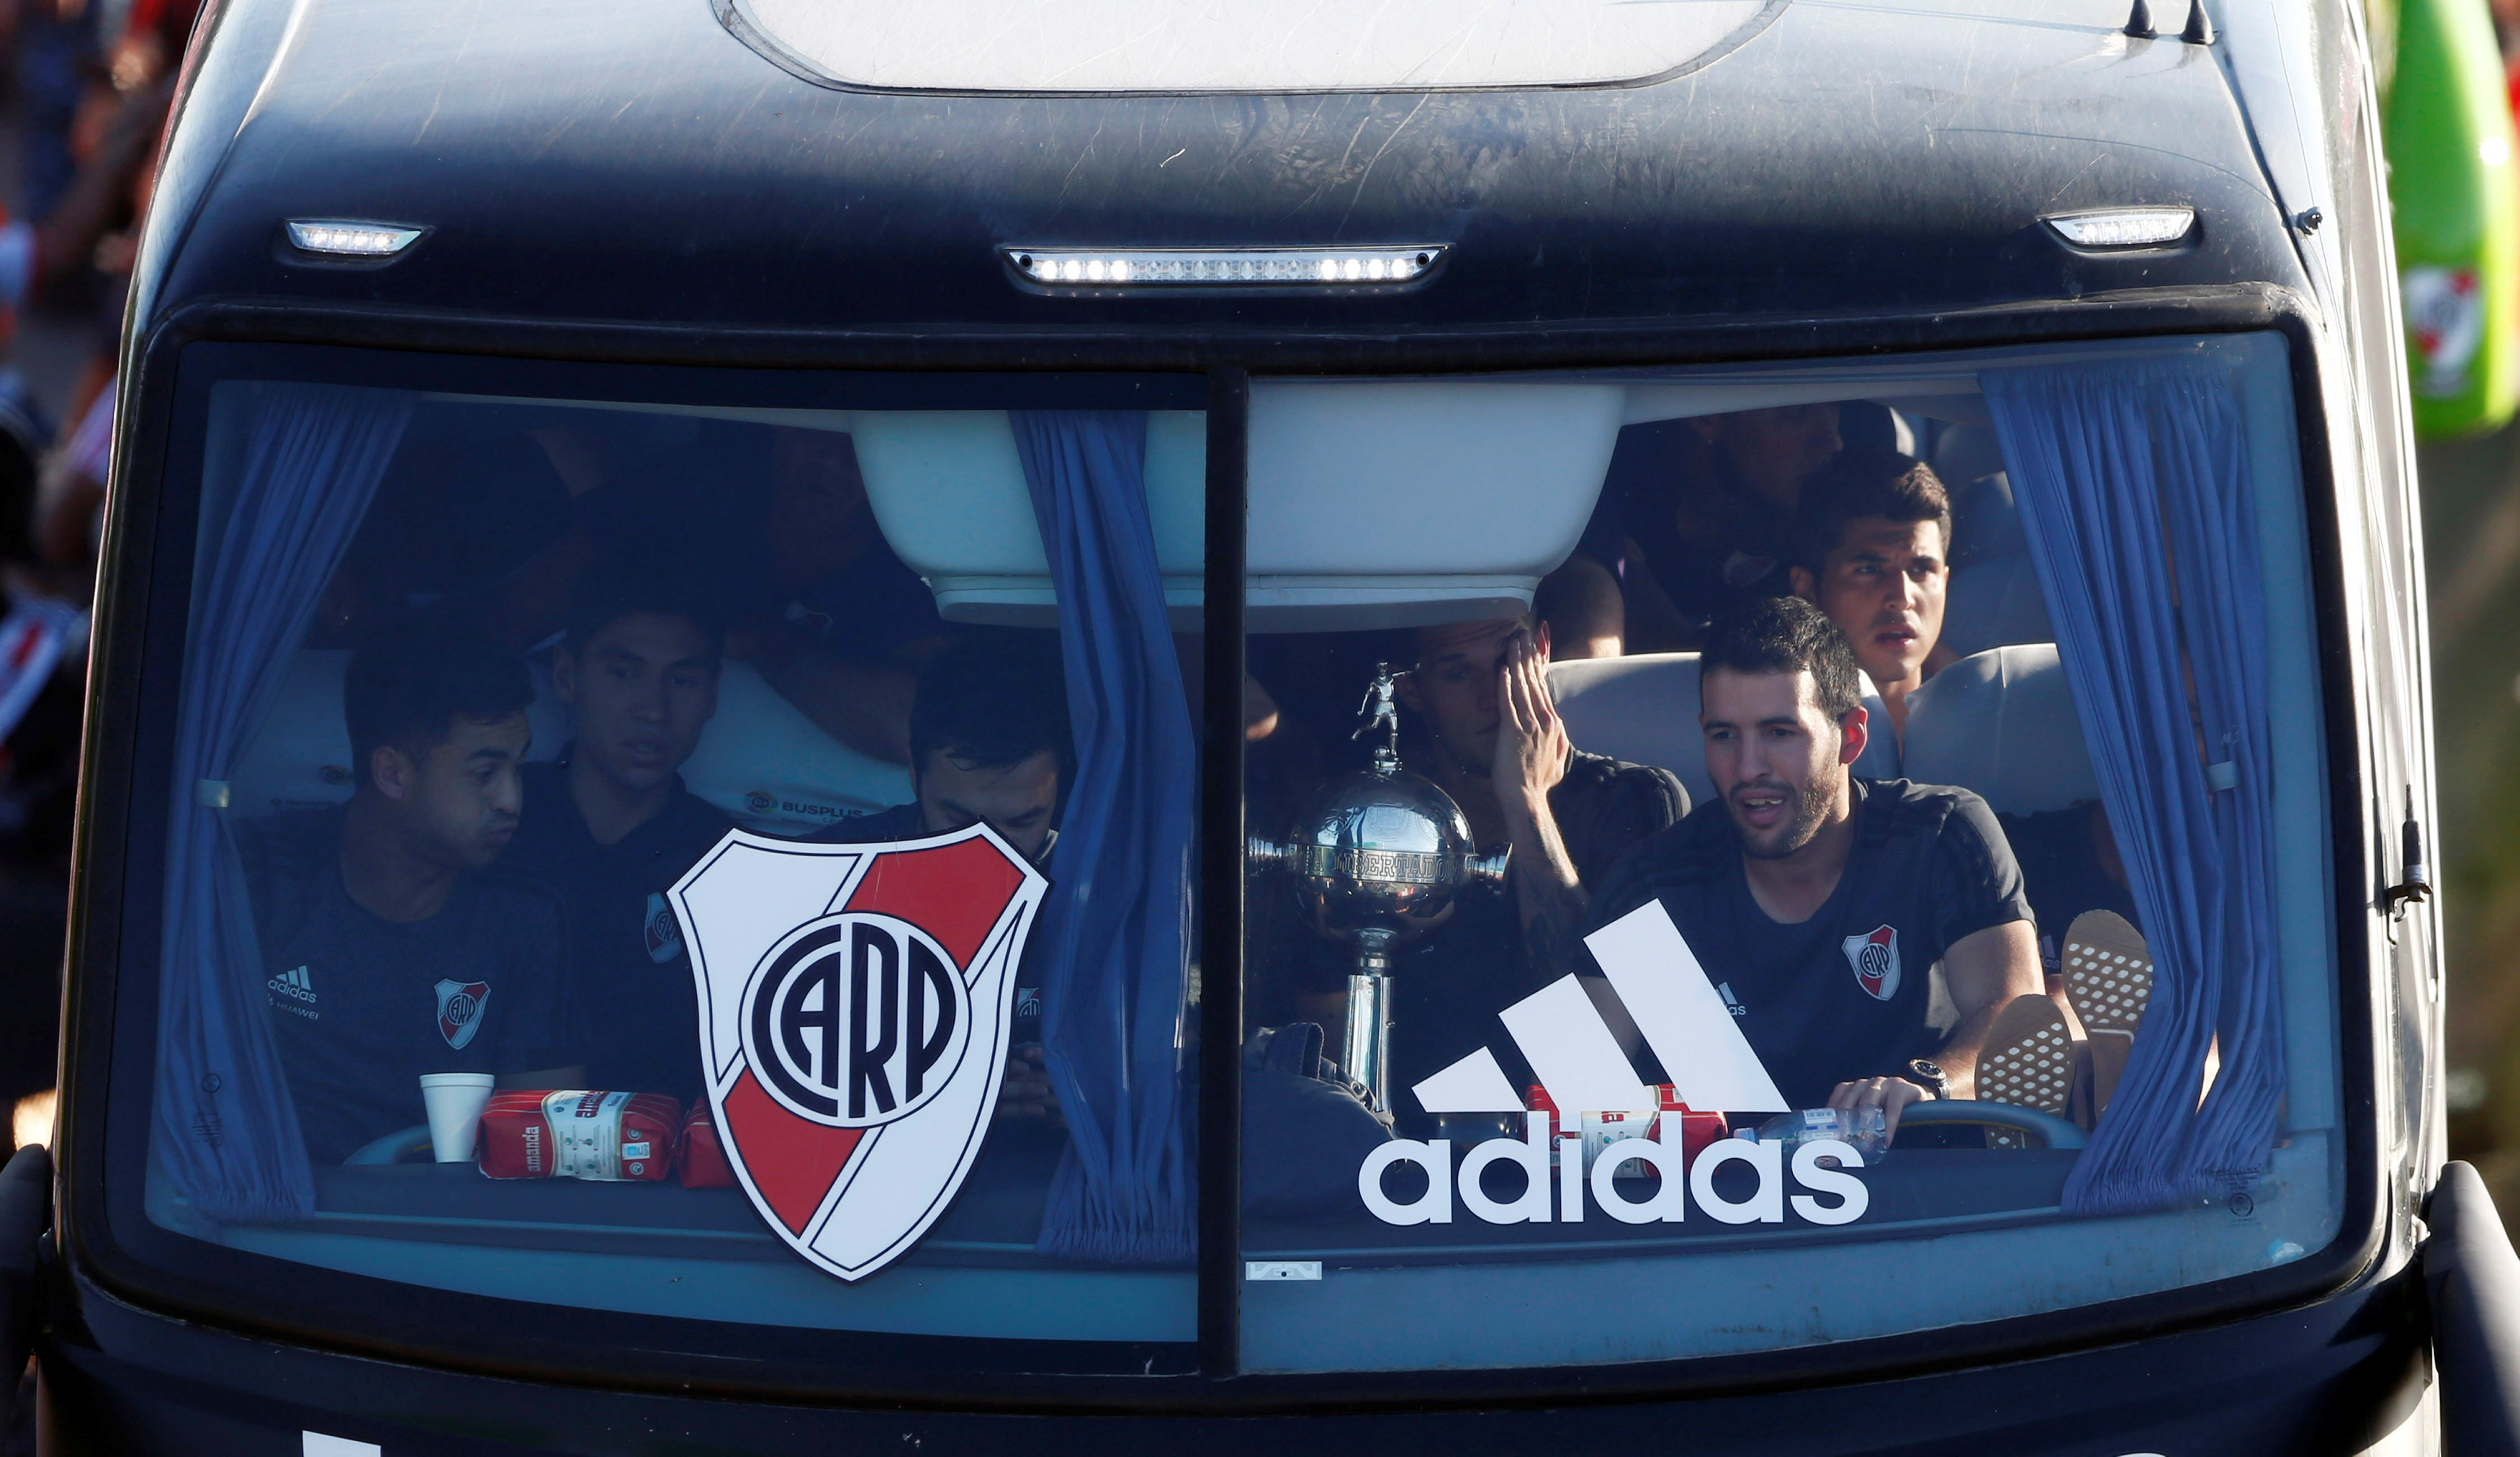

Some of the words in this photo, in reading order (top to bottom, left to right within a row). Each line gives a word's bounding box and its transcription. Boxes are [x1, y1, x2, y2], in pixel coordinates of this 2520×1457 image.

[782, 801, 863, 817] BUSPLUS
[268, 979, 317, 1003] adidas
[277, 1002, 319, 1020] HUAWEI
[521, 1126, 541, 1173] amanda
[1359, 1111, 1869, 1226] adidas
